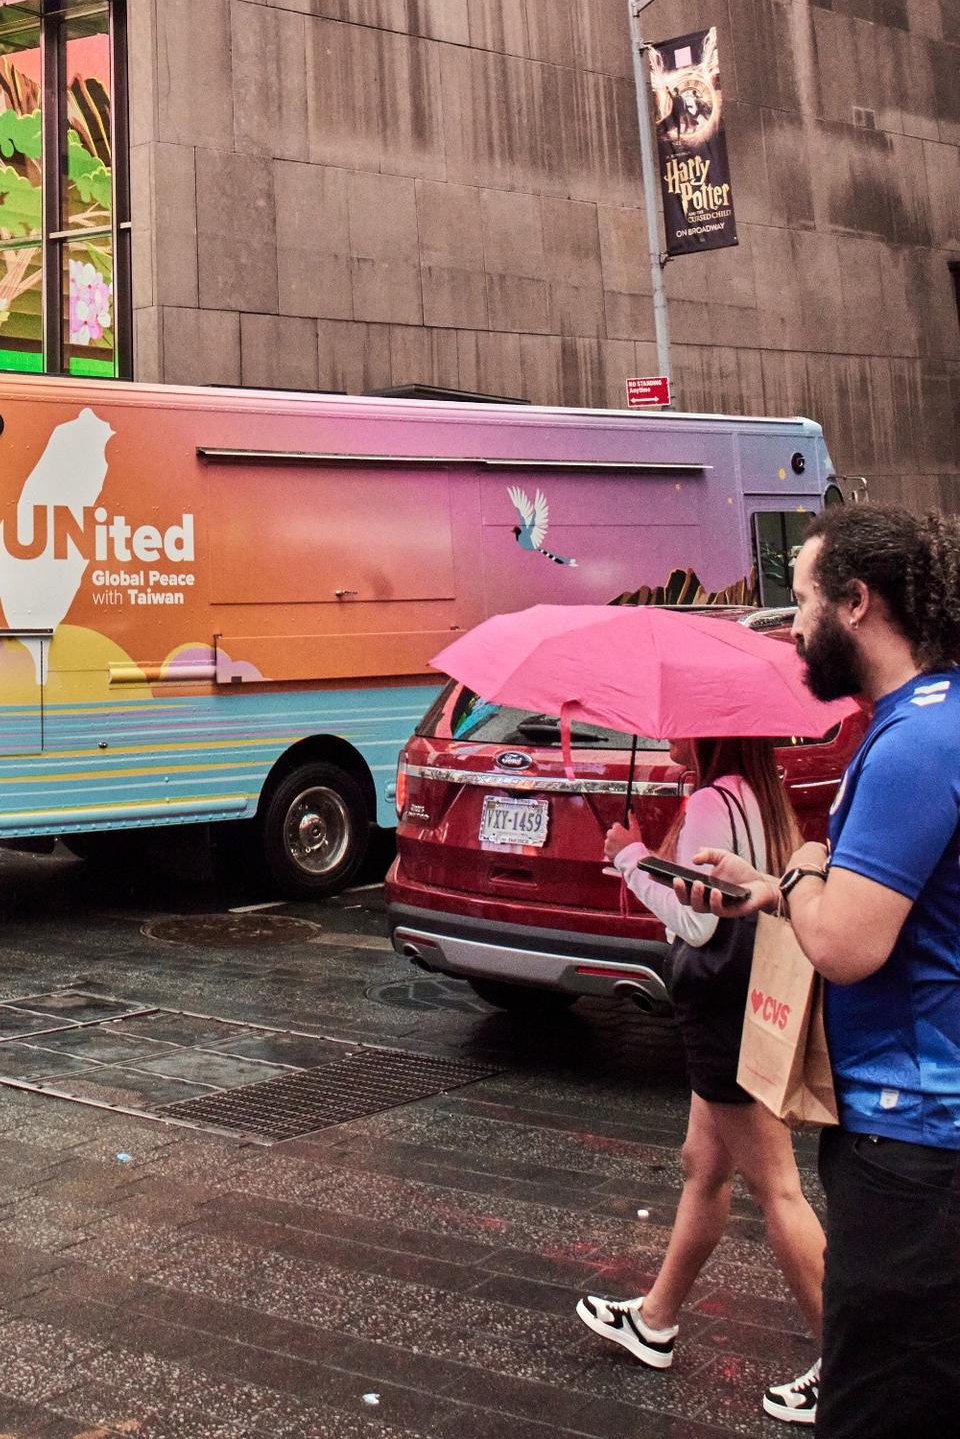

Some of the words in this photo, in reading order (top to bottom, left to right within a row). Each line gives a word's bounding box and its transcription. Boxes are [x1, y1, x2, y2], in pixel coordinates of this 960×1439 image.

[663, 155, 711, 194] Harry
[679, 181, 730, 218] Potter
[687, 213, 712, 223] CURSED
[711, 209, 732, 220] CHILD
[676, 229, 688, 238] ON
[688, 222, 726, 236] BROADWAY
[637, 379, 663, 387] STANDING
[3, 504, 195, 562] UNited
[92, 570, 144, 587] Global
[148, 571, 195, 587] Peace
[92, 589, 123, 605] with
[128, 589, 184, 605] Taiwan
[486, 809, 543, 833] VXY-1459
[762, 995, 791, 1031] CVS
